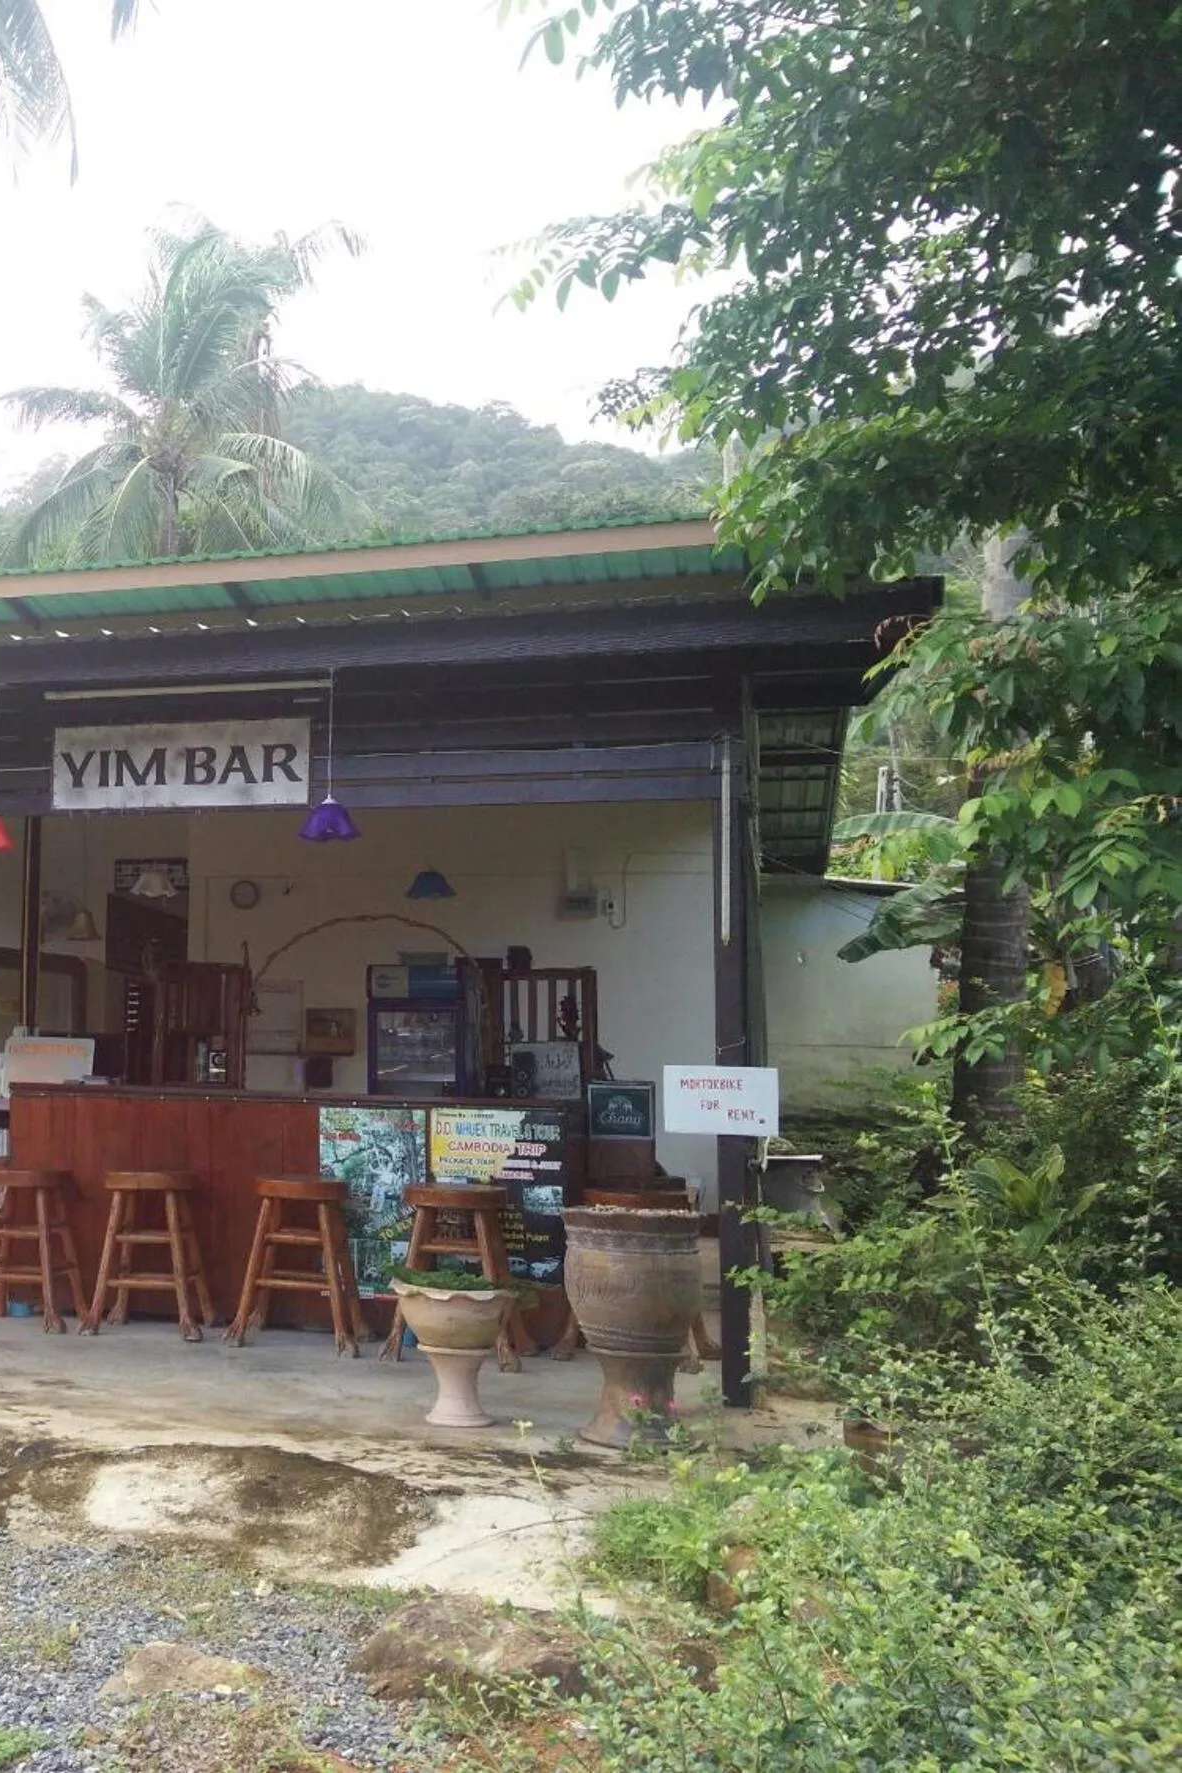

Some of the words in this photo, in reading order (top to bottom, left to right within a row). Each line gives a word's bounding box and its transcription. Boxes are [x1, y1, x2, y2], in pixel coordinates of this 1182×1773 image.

[61, 747, 167, 788] YIM
[183, 743, 303, 785] BAR
[700, 1099, 720, 1111] FOR
[447, 1139, 511, 1154] CAMBODIA
[517, 1142, 547, 1156] TRIP
